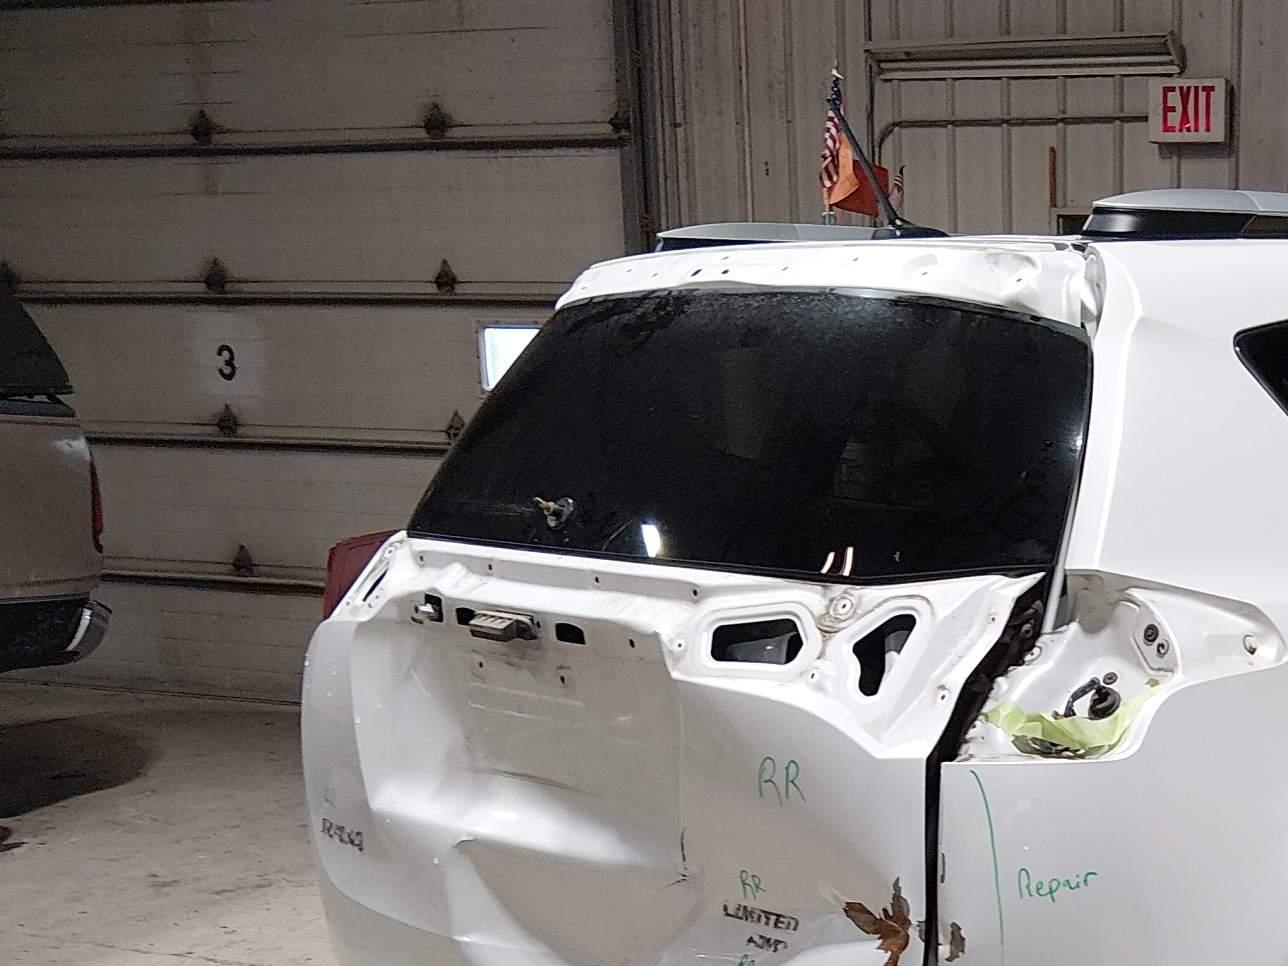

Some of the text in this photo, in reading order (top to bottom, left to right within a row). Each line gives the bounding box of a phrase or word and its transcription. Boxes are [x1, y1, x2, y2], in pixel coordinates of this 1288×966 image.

[1161, 86, 1216, 132] EXIT
[216, 344, 238, 381] 3
[757, 755, 808, 807] RR
[739, 869, 767, 900] RR
[1017, 867, 1099, 903] Repair
